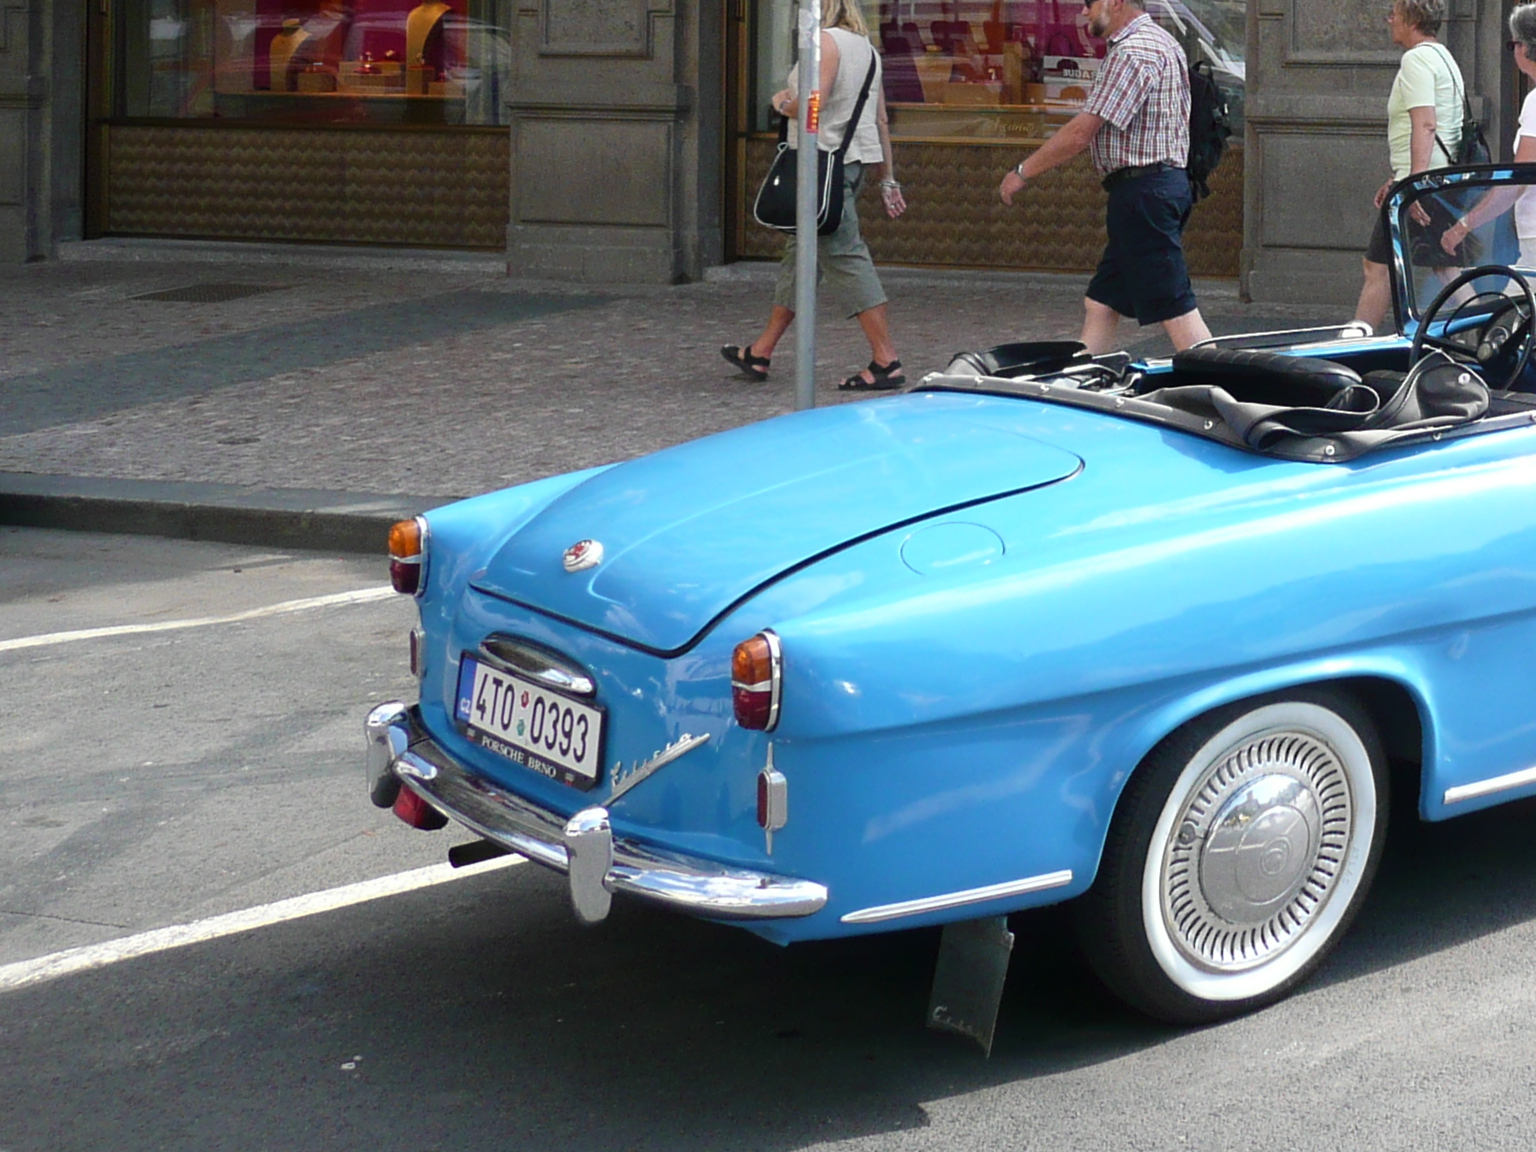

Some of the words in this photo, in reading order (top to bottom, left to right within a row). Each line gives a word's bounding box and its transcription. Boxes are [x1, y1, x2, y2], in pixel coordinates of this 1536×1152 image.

[460, 697, 471, 715] CZ
[530, 696, 589, 764] 0393
[481, 736, 526, 764] PORSCHE
[528, 756, 557, 778] BRNO
